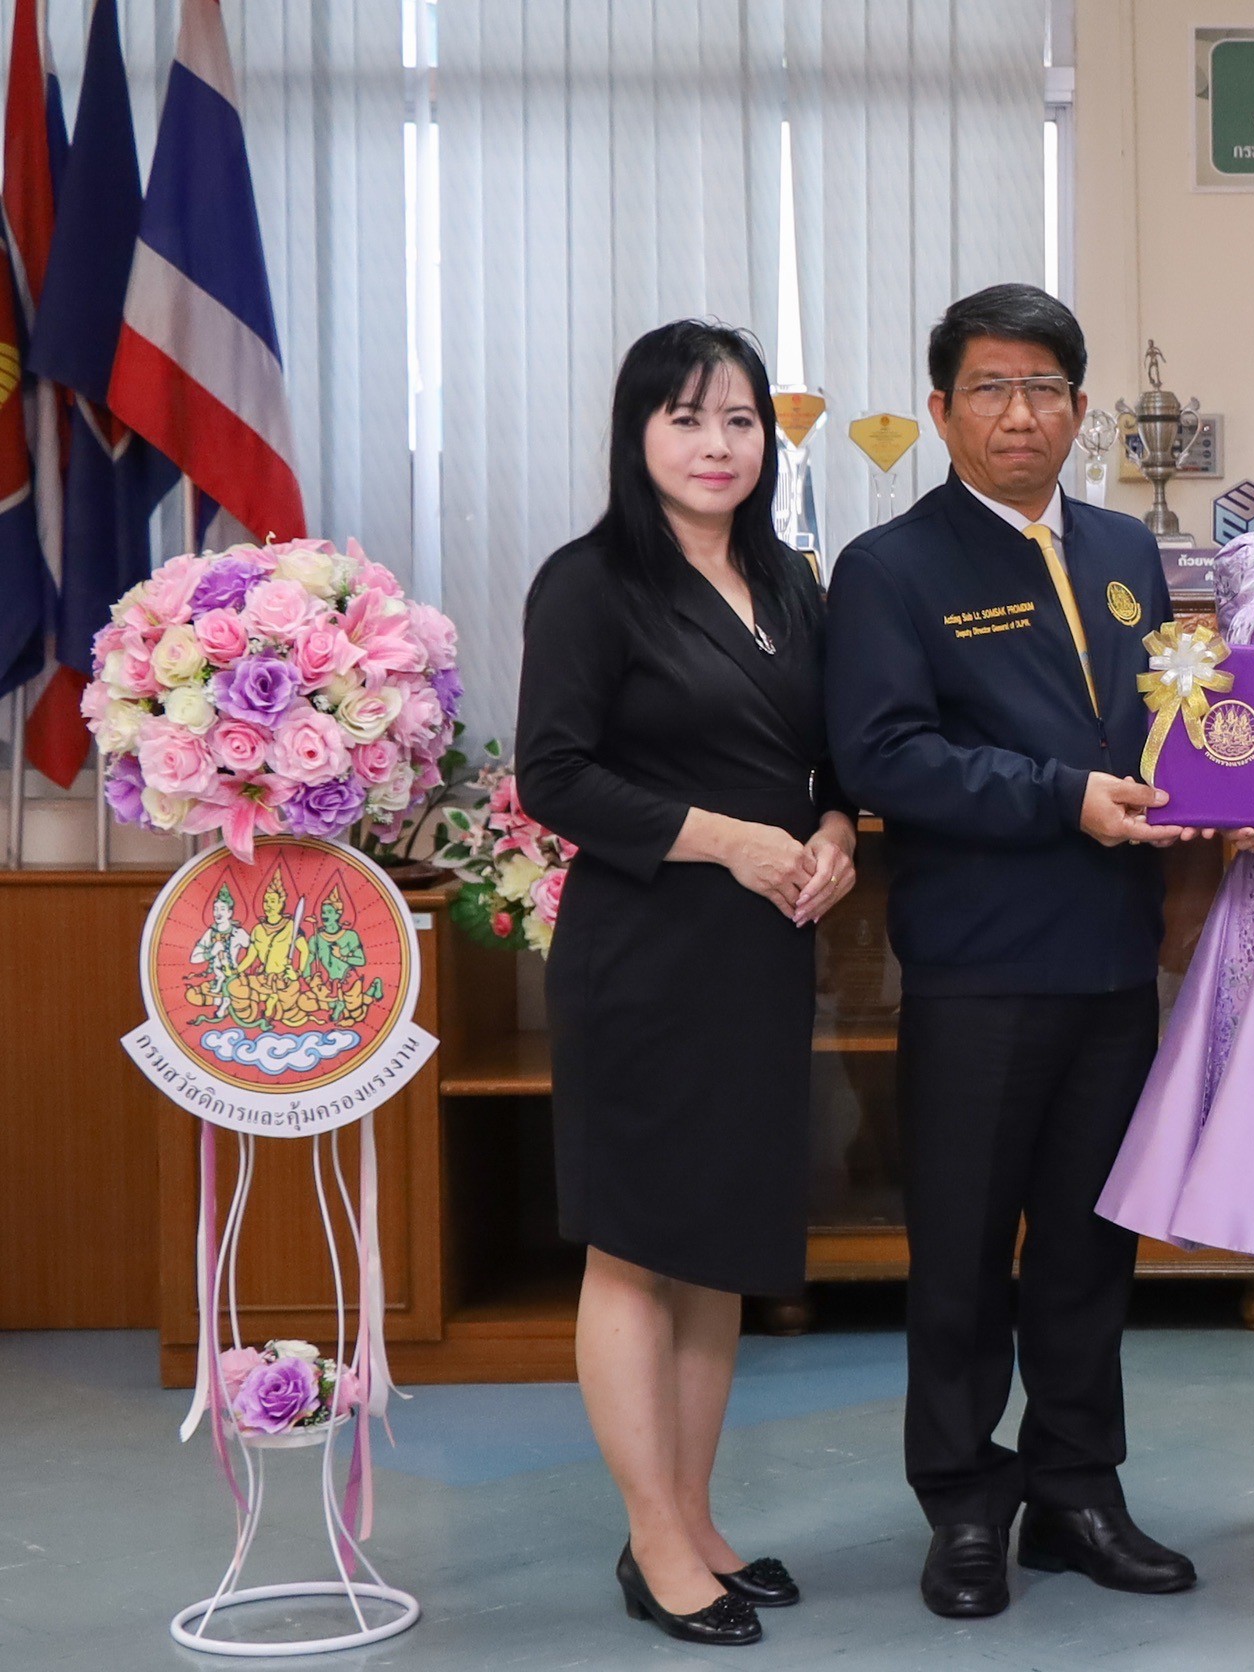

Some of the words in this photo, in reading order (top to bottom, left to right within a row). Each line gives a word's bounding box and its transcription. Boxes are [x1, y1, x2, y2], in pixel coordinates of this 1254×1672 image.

[982, 607, 1007, 619] SOMSAK
[135, 1033, 420, 1132] กรมสวัสดิการและคุ้มครองแรงงาน
